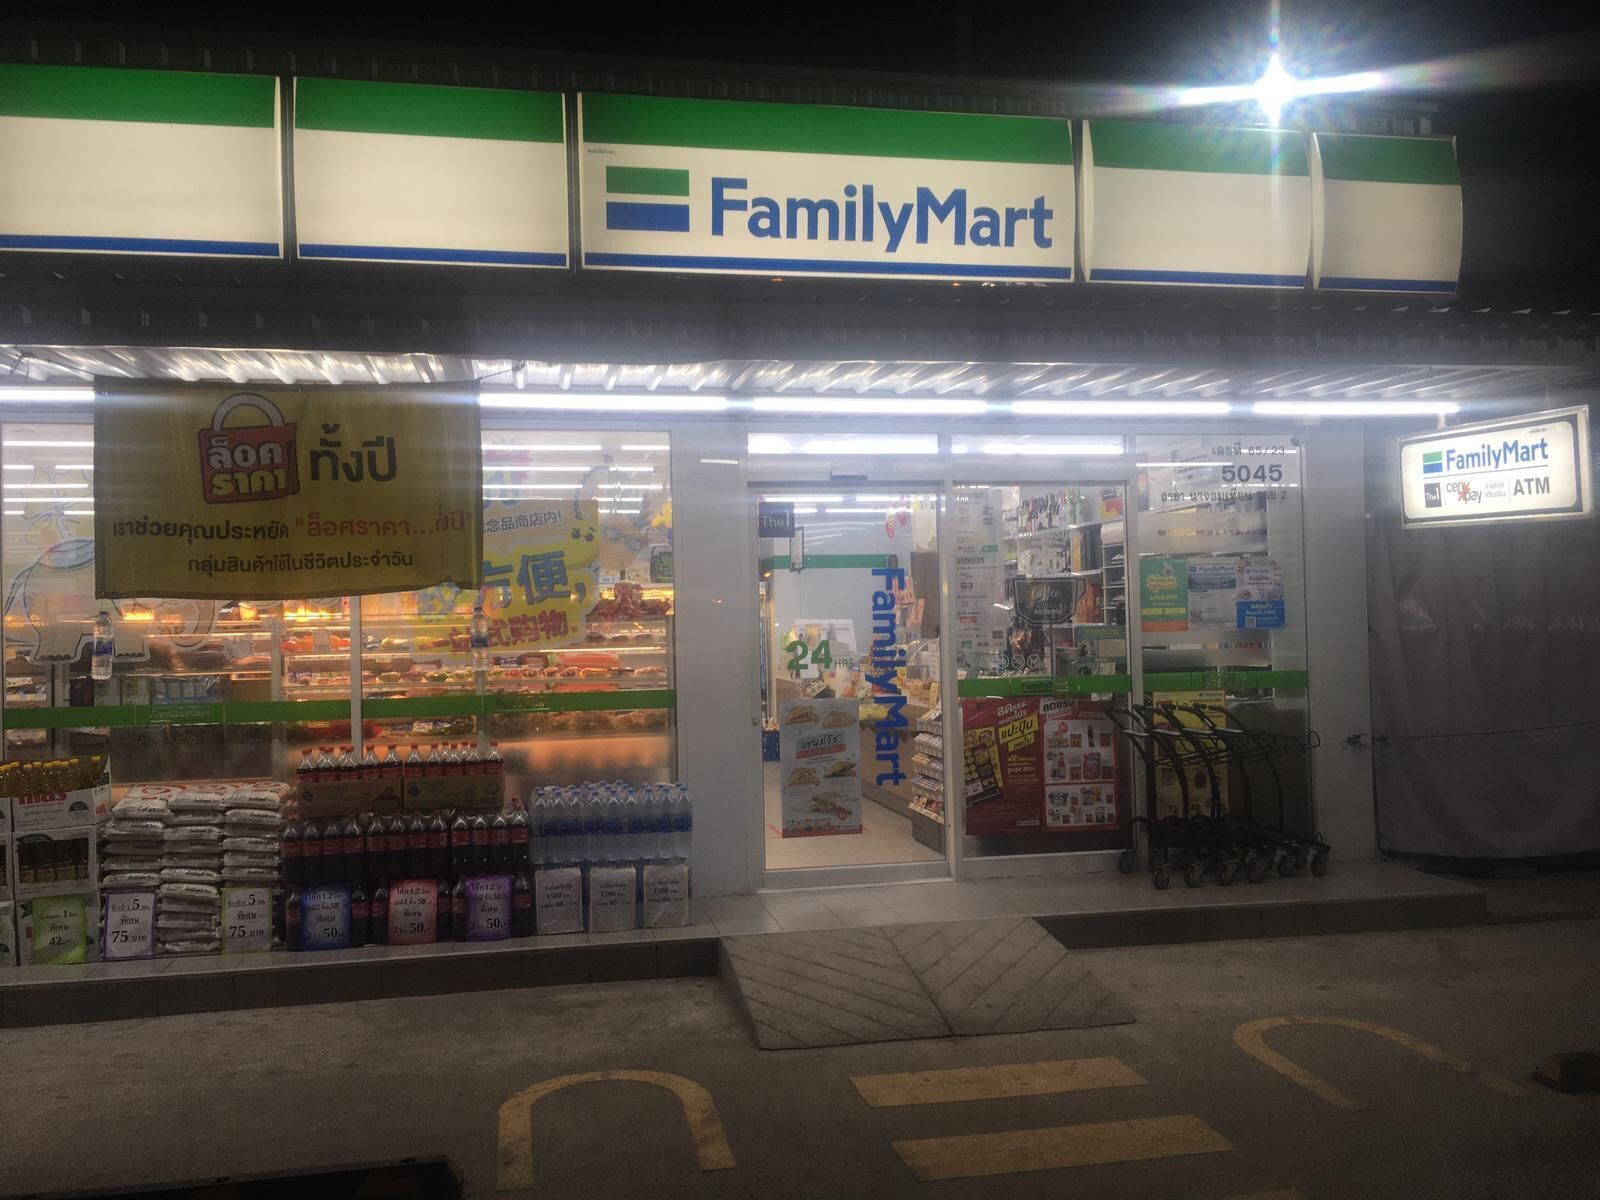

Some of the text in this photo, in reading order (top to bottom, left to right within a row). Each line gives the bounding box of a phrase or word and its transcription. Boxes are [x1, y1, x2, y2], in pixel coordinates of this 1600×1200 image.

[710, 176, 1054, 253] FamilyMart
[309, 423, 398, 482] ทั้งปี
[1445, 437, 1549, 471] FamilyMart
[211, 468, 287, 496] ราคา
[1222, 464, 1283, 483] 5045
[1513, 477, 1551, 496] ATM
[112, 515, 289, 546] เราช่วยคุณประหยัด
[188, 548, 414, 577] กลุ่มสินค้าใช้ในชีวิตประจำวัน
[784, 639, 832, 671] 24
[864, 568, 910, 786] FamilyMart
[132, 898, 140, 910] 5
[248, 894, 256, 905] 5
[111, 930, 129, 943] 75
[229, 925, 246, 938] 75
